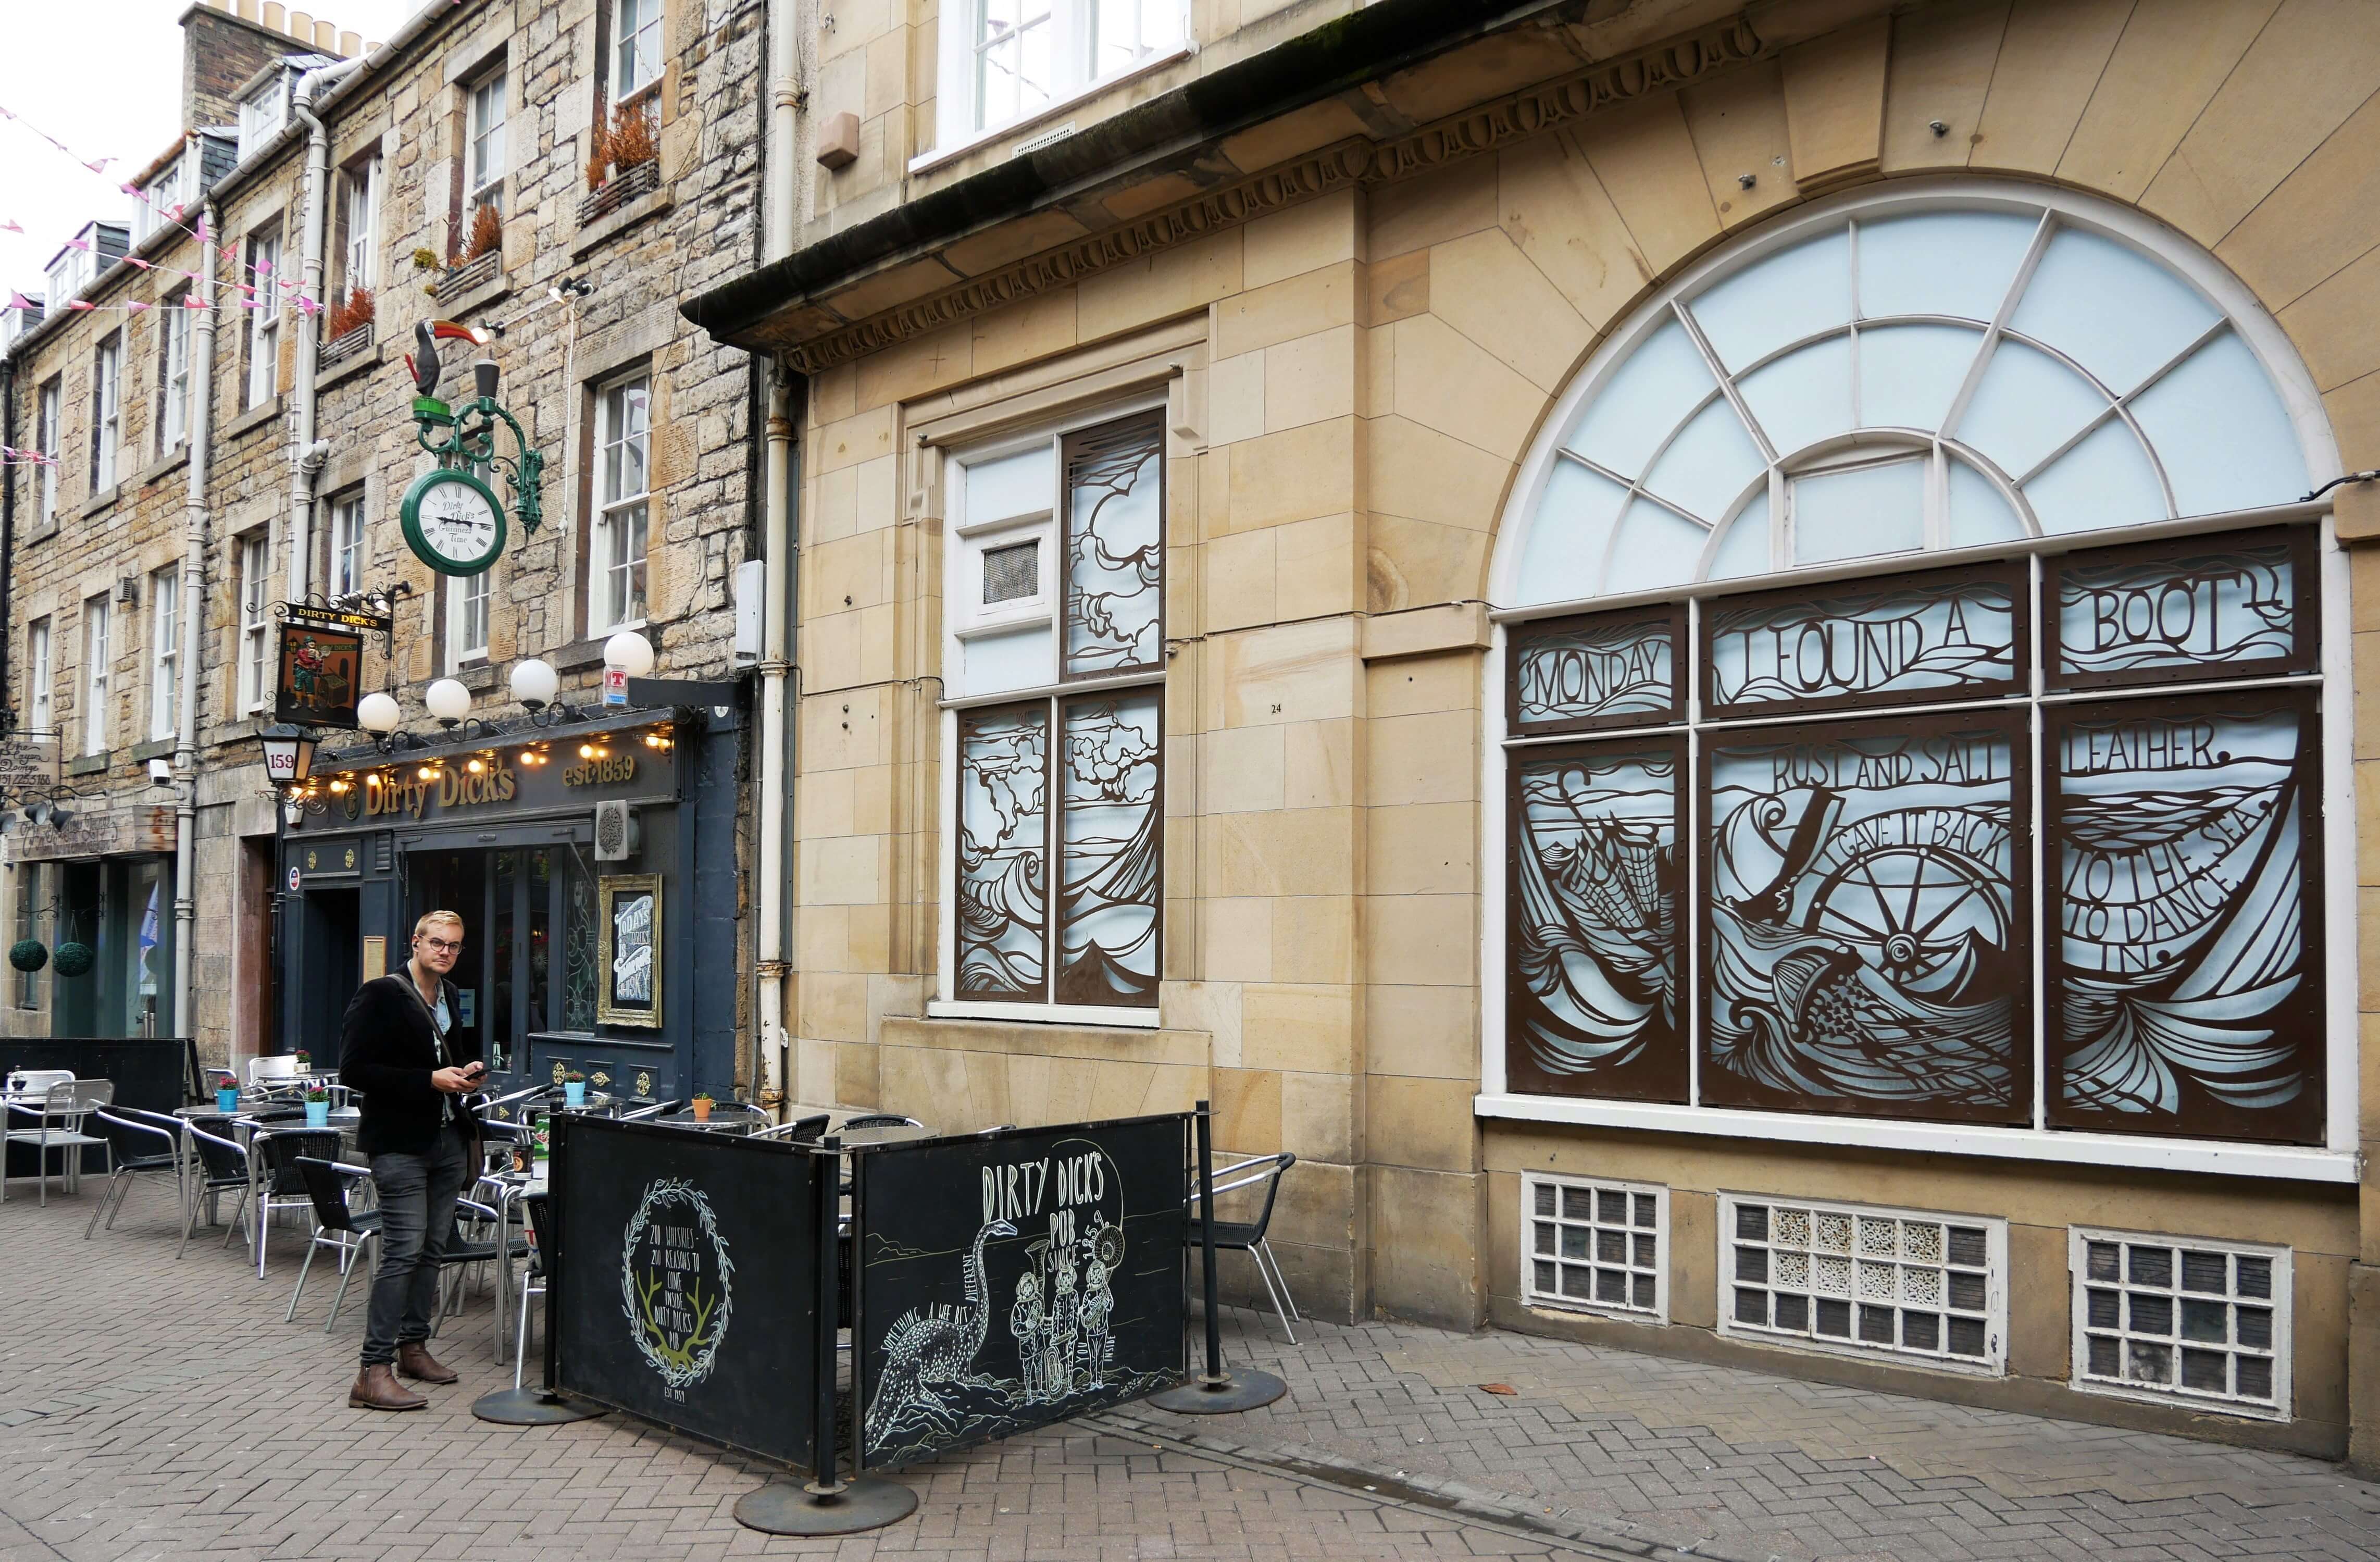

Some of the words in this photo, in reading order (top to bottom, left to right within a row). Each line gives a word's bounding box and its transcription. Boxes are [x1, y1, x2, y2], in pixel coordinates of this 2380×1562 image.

[443, 501, 464, 513] Dirty
[439, 521, 472, 534] Guinness
[448, 533, 467, 543] Time
[297, 608, 337, 621] DIRTY
[341, 615, 378, 627] DICK'S
[1535, 641, 1662, 705] MONDAY
[1774, 618, 1923, 692] FOUND
[1943, 596, 1972, 646] A
[1272, 704, 1281, 713] 24
[270, 754, 294, 768] 159
[1773, 743, 1842, 793] RUST
[1856, 752, 1913, 787] AND
[365, 774, 429, 819] Dirty
[438, 759, 515, 807] Dick's
[1838, 817, 1892, 859] GAVE
[1932, 810, 2011, 869] BACK
[2064, 844, 2113, 902] TO
[2117, 836, 2192, 902] THE
[2065, 900, 2109, 941] TO
[2123, 864, 2241, 944] DANCE
[982, 1157, 1049, 1225] DIRTY
[1058, 1151, 1104, 1207] DICK'S
[650, 1224, 661, 1246] 200
[1050, 1208, 1076, 1249] PUB
[651, 1249, 662, 1266] 200
[665, 1249, 691, 1271] REASONS
[692, 1252, 700, 1273] TO
[1047, 1245, 1080, 1272] SINCE
[667, 1271, 682, 1292] COME
[880, 1307, 921, 1355] SOMETHING
[929, 1301, 933, 1319] A
[939, 1303, 952, 1321] WEE
[963, 1254, 978, 1301] DIFFERENT
[655, 1305, 669, 1327] DIRTY
[673, 1309, 692, 1333] DICK'S
[669, 1331, 679, 1351] PUB
[1075, 1342, 1090, 1363] YOU
[1104, 1335, 1116, 1361] INSIDE
